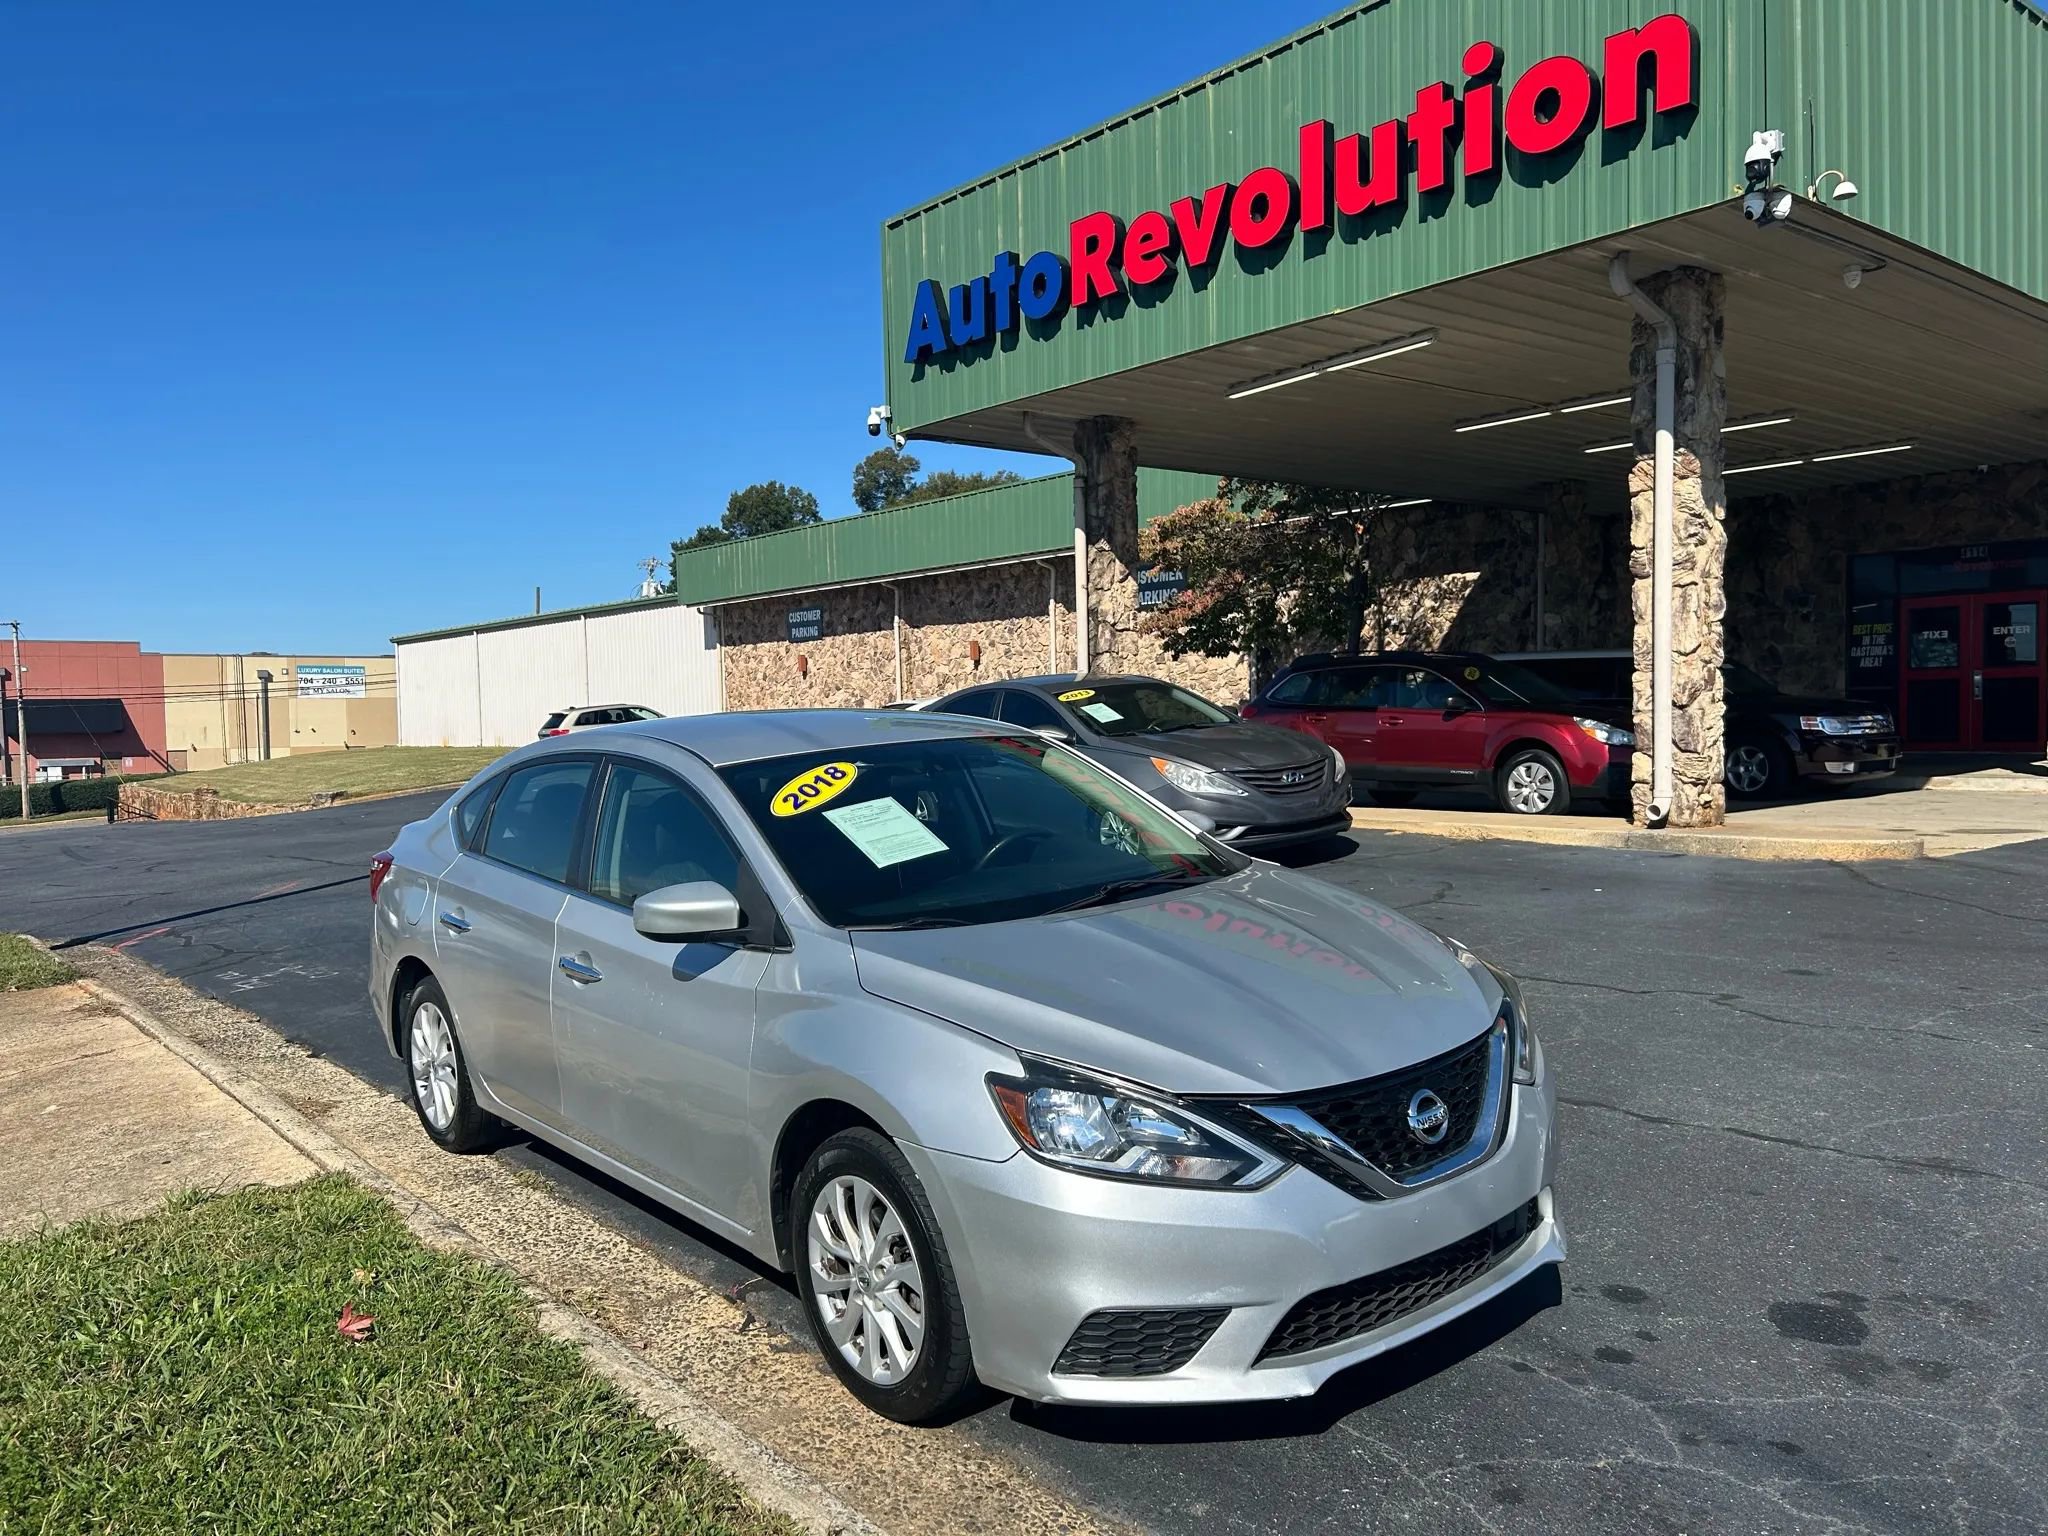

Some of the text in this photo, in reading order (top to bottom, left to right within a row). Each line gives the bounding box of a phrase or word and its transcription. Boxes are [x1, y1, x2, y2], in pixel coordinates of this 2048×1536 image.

[904, 14, 1698, 364] AutoRevolution
[1138, 568, 1184, 584] STOMER
[1138, 588, 1178, 604] ARKIN
[789, 610, 821, 623] CUSTOMER
[791, 626, 819, 638] PARKING
[1852, 623, 1894, 635] BEST PRICE
[1992, 625, 2030, 635] ENTER
[1862, 635, 1887, 645] IN THE
[1859, 656, 1883, 667] AREA!
[1063, 690, 1091, 700] 2013
[782, 766, 847, 811] 2018
